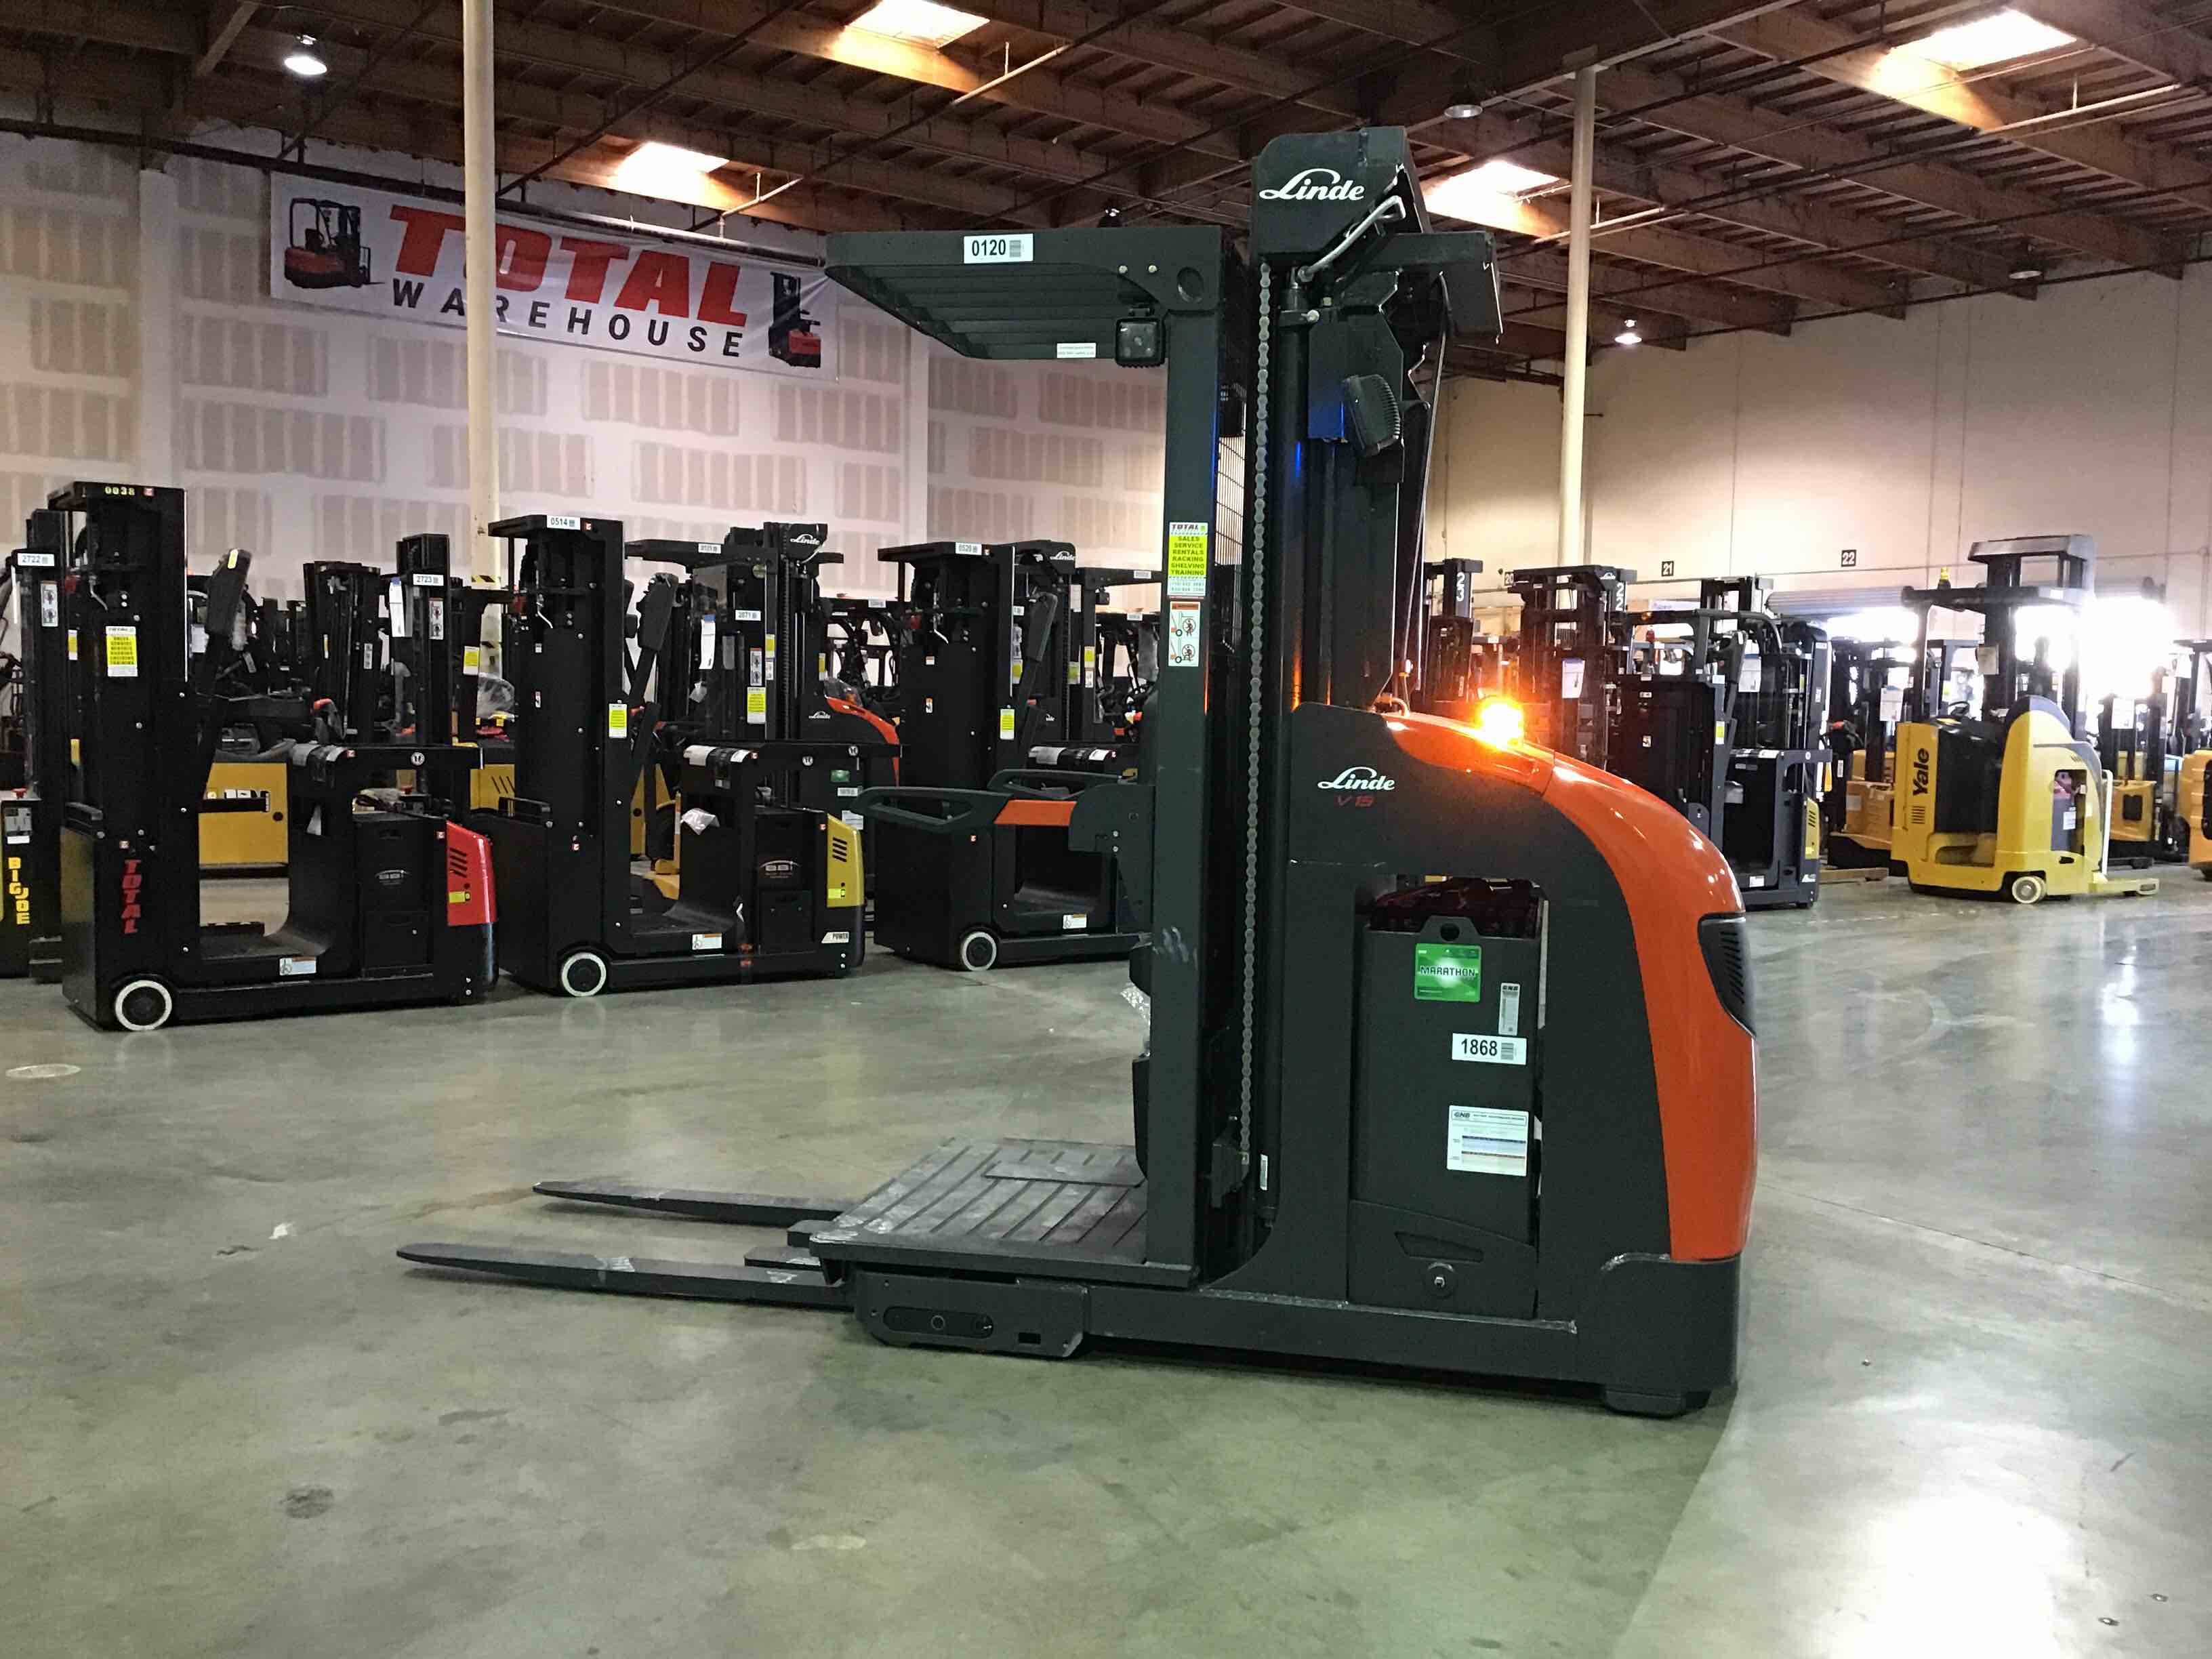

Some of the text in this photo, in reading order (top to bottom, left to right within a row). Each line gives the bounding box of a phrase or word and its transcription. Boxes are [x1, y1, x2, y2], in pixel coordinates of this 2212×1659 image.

[1258, 167, 1365, 201] Linde
[972, 239, 1006, 256] 0120
[390, 205, 747, 327] TOTAL
[392, 278, 743, 357] WAREHOUSE
[550, 517, 568, 527] 0514
[21, 555, 41, 563] 2722
[1843, 552, 1855, 565] 22
[1662, 562, 1673, 575] 21
[417, 575, 432, 583] 2723
[1456, 571, 1465, 602] 23
[1317, 766, 1395, 790] Linde
[1912, 747, 1930, 796] Yale
[121, 859, 142, 934] TOTAL
[1420, 966, 1476, 977] MARATHON
[1461, 1038, 1498, 1057] 1868
